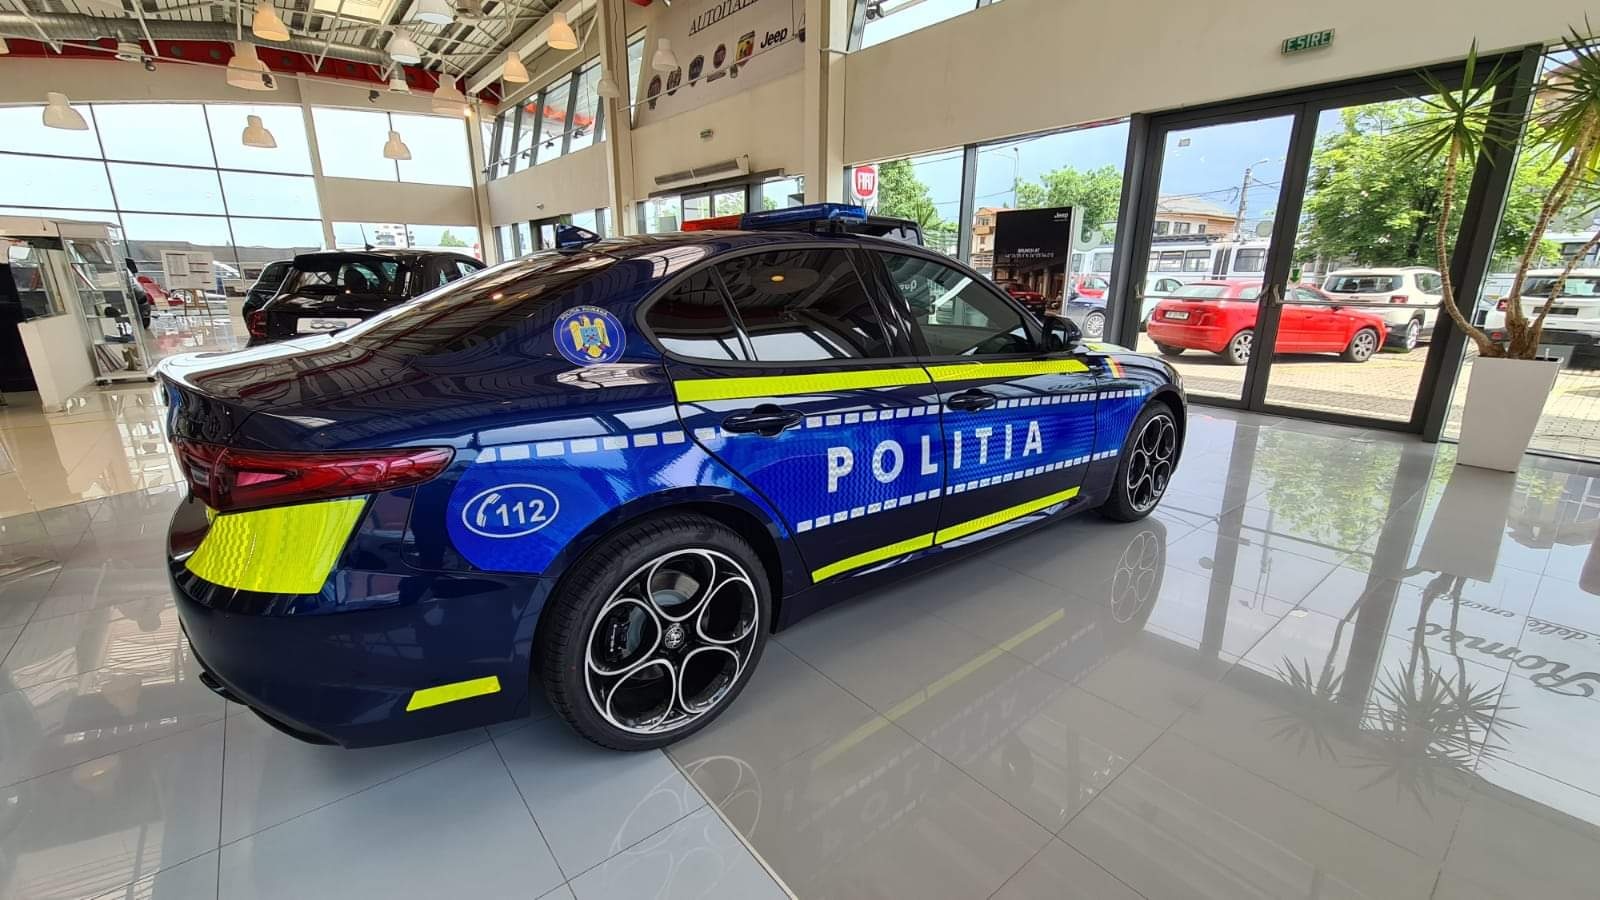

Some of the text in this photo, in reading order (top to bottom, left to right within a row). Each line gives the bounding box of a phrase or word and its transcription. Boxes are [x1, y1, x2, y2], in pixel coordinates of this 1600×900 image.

[760, 27, 788, 49] Jeep
[857, 172, 875, 190] FIAT
[827, 420, 1044, 493] POLITIA
[495, 498, 546, 527] 112
